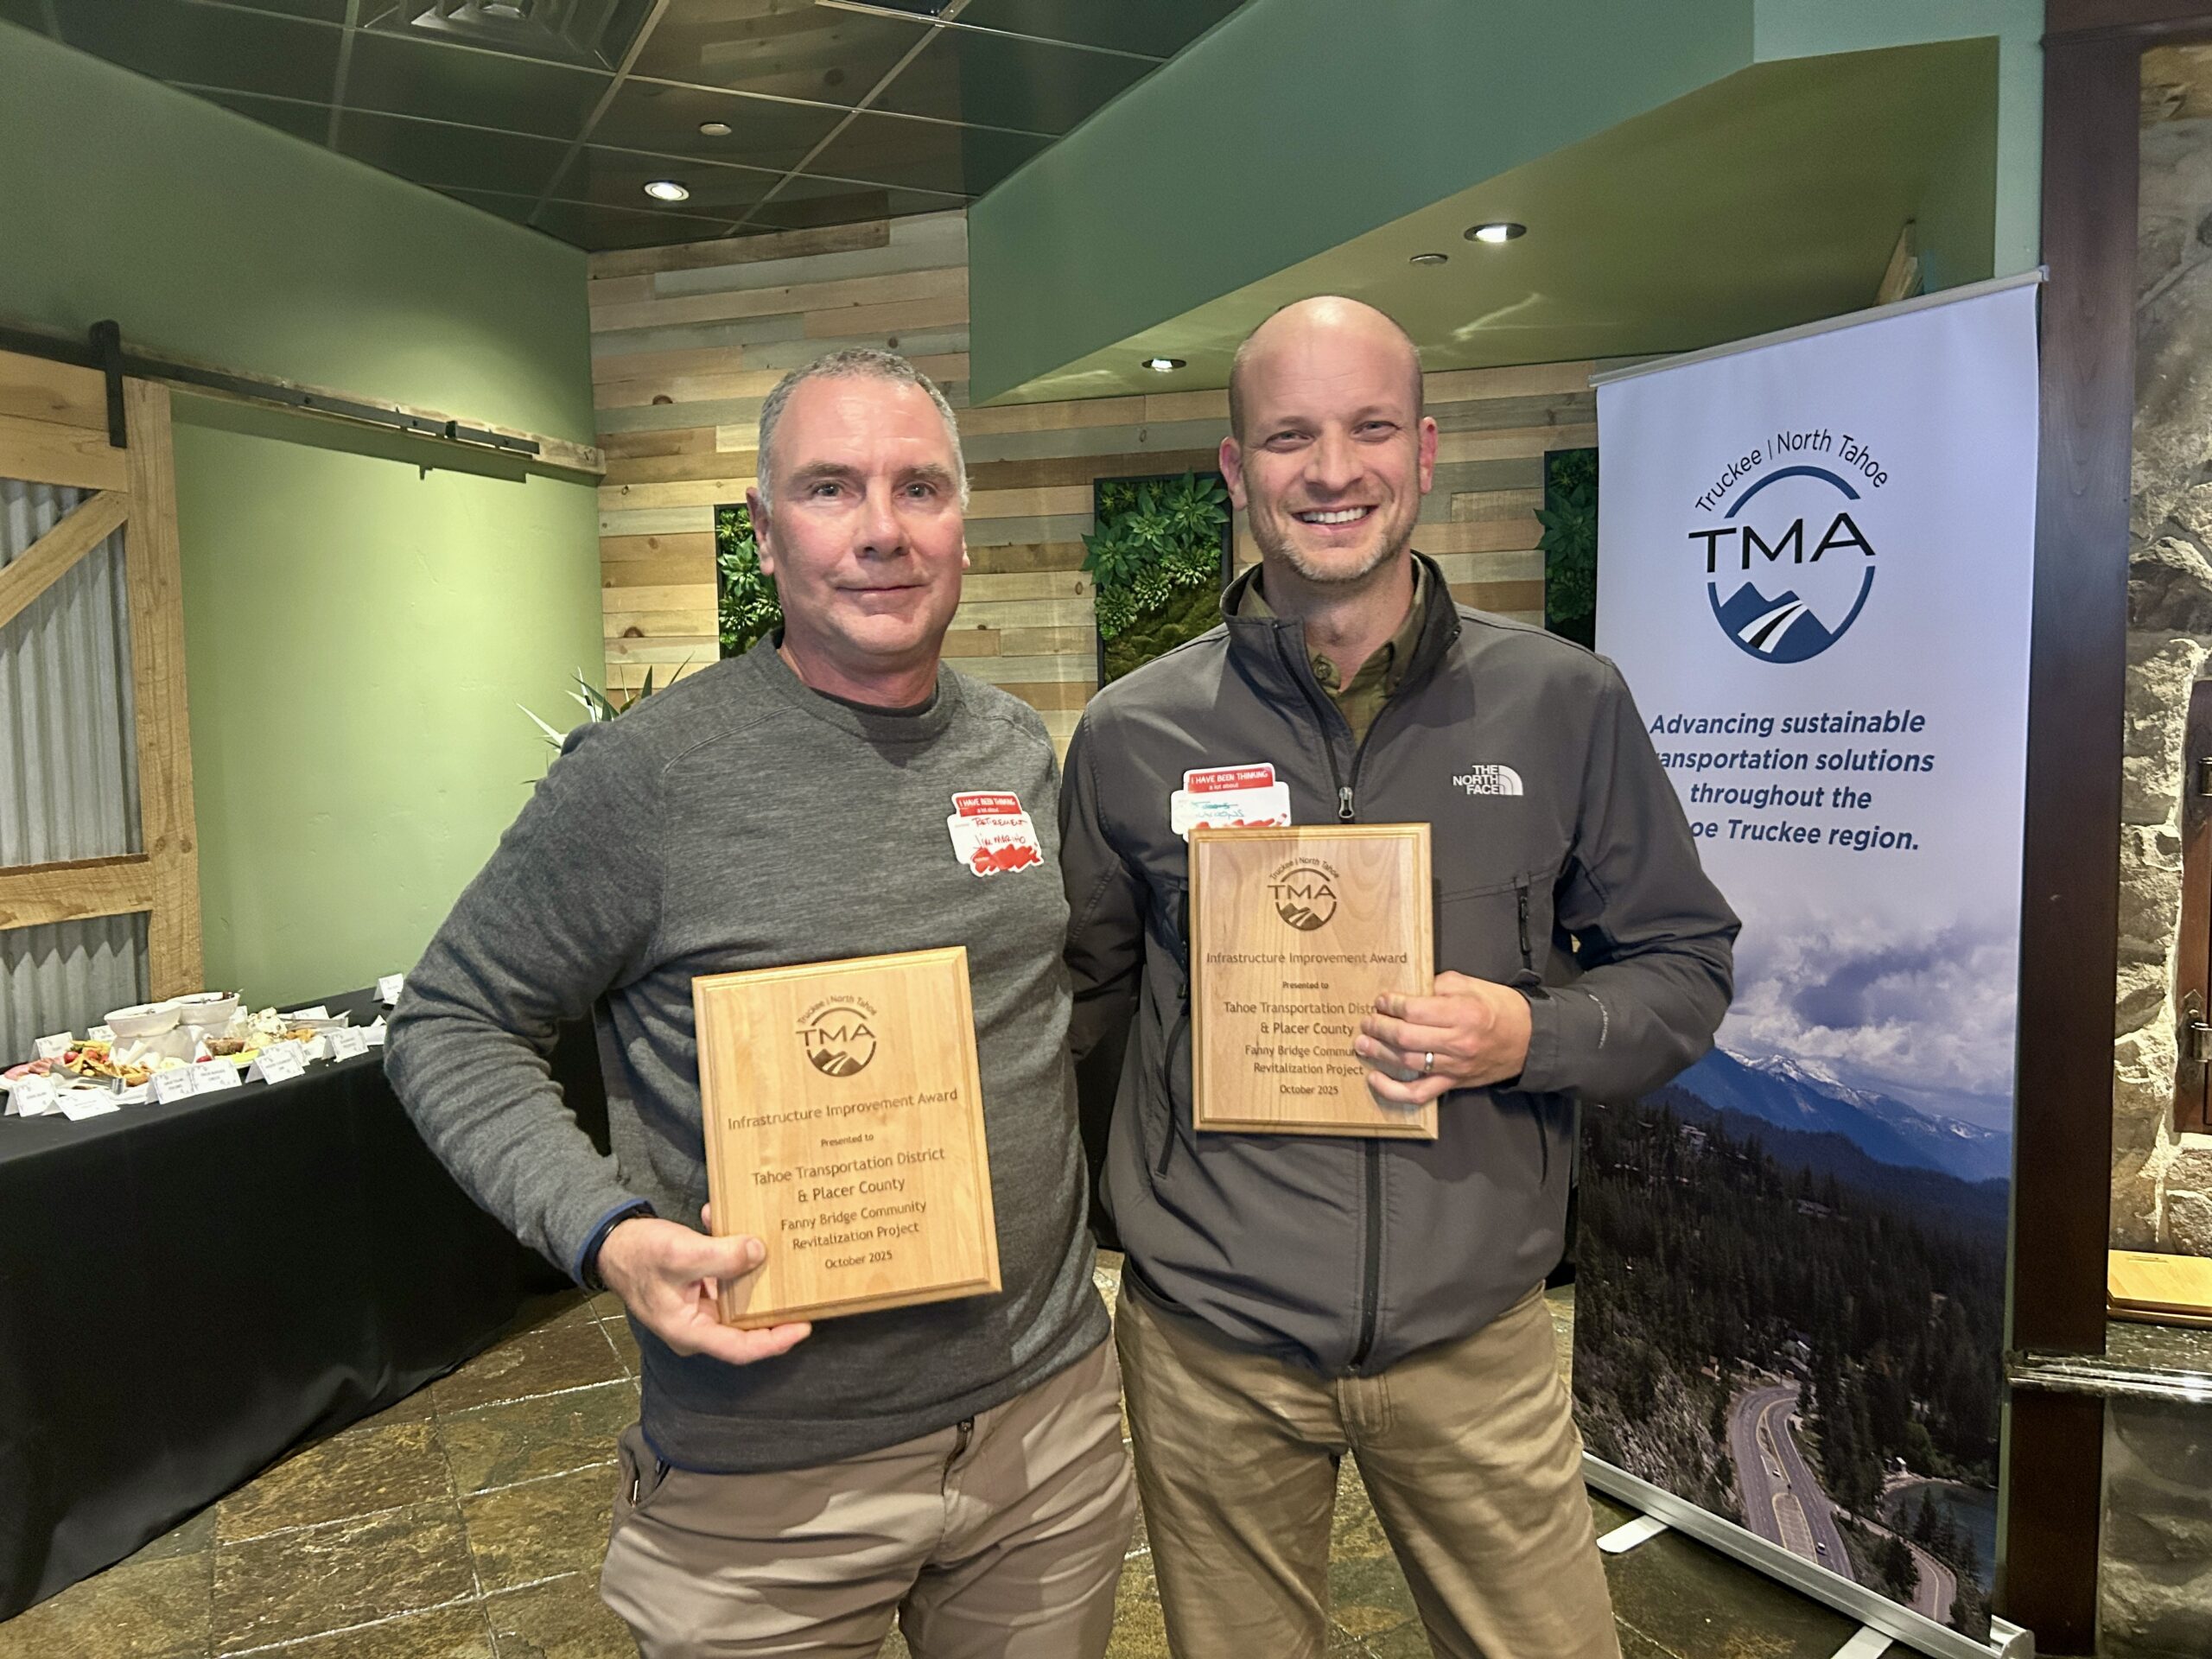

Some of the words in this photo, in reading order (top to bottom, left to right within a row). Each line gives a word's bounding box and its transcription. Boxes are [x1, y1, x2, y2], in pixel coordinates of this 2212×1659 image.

[1694, 449, 1763, 512] Truckee
[1777, 429, 1833, 454] North
[1838, 435, 1889, 488] Tahoe
[1688, 512, 1877, 573] TMA
[1649, 713, 1774, 737] Advancing
[1780, 709, 1926, 734] sustainable
[1656, 748, 1808, 772] ansportation
[1815, 748, 1936, 772] solutions
[1471, 765, 1499, 775] THE
[1452, 774, 1498, 785] NORTH
[1466, 785, 1499, 795] FACE
[1689, 782, 1825, 809] throughout
[1831, 785, 1872, 809] the
[1727, 818, 1821, 843] Truckee
[1827, 825, 1919, 851] region.
[1299, 856, 1320, 865] North
[1267, 884, 1337, 899] TMA
[1206, 952, 1286, 963] Infrastructure
[1289, 952, 1367, 966] Improvement
[1370, 952, 1408, 963] Award
[1282, 981, 1319, 989] Presented
[830, 995, 855, 1003] North
[1224, 1001, 1257, 1014] Tahoe
[1260, 1001, 1344, 1016] Transportation
[1348, 1002, 1378, 1014] Distr
[796, 1023, 876, 1046] TMA
[1260, 1022, 1269, 1033] &
[1273, 1022, 1310, 1034] Placer
[1313, 1022, 1354, 1037] County
[1245, 1045, 1274, 1057] Fanny
[1277, 1045, 1310, 1058] Bridge
[1254, 1063, 1323, 1075] Revitalization
[1325, 1064, 1364, 1077] Project
[1280, 1084, 1314, 1095] October
[1318, 1084, 1338, 1095] 2025
[728, 1107, 823, 1130] Infrastructure
[826, 1095, 914, 1117] Improvement
[918, 1088, 958, 1103] Award
[820, 1134, 862, 1147] Presented
[865, 1133, 874, 1141] to
[753, 1166, 792, 1185] Tahoe
[796, 1155, 893, 1180] Transportation
[897, 1147, 945, 1165] District
[798, 1190, 809, 1203] &
[812, 1185, 856, 1201] Placer
[859, 1178, 906, 1194] County
[781, 1217, 816, 1231] Fanny
[820, 1211, 857, 1226] Bridge
[861, 1200, 927, 1219] Community
[792, 1229, 874, 1250] Revitalization
[877, 1222, 919, 1238] Project
[824, 1255, 865, 1269] October
[869, 1250, 893, 1262] 2025
